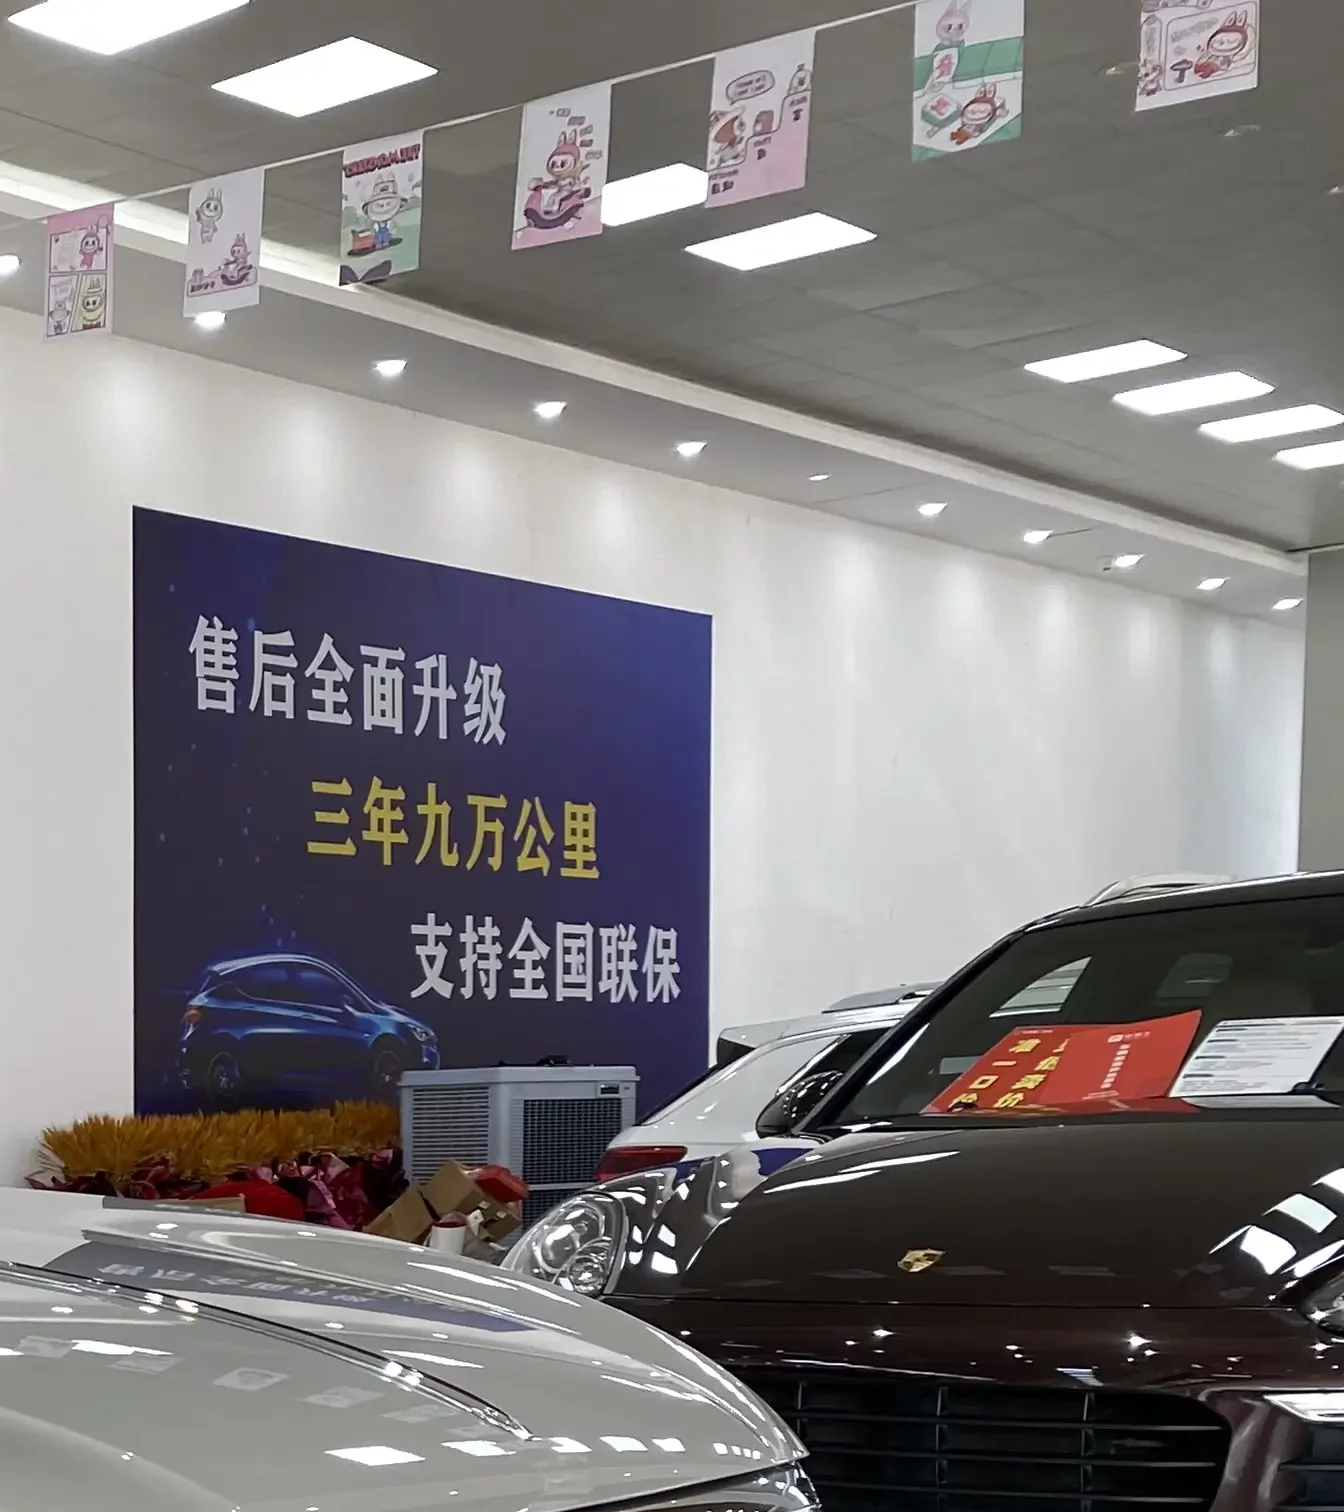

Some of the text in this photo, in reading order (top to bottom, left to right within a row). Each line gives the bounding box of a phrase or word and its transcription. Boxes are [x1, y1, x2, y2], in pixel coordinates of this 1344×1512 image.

[188, 615, 506, 745] 售后全面升级
[307, 776, 600, 879] 三年九万公里
[410, 913, 680, 1004] 支持全国联保
